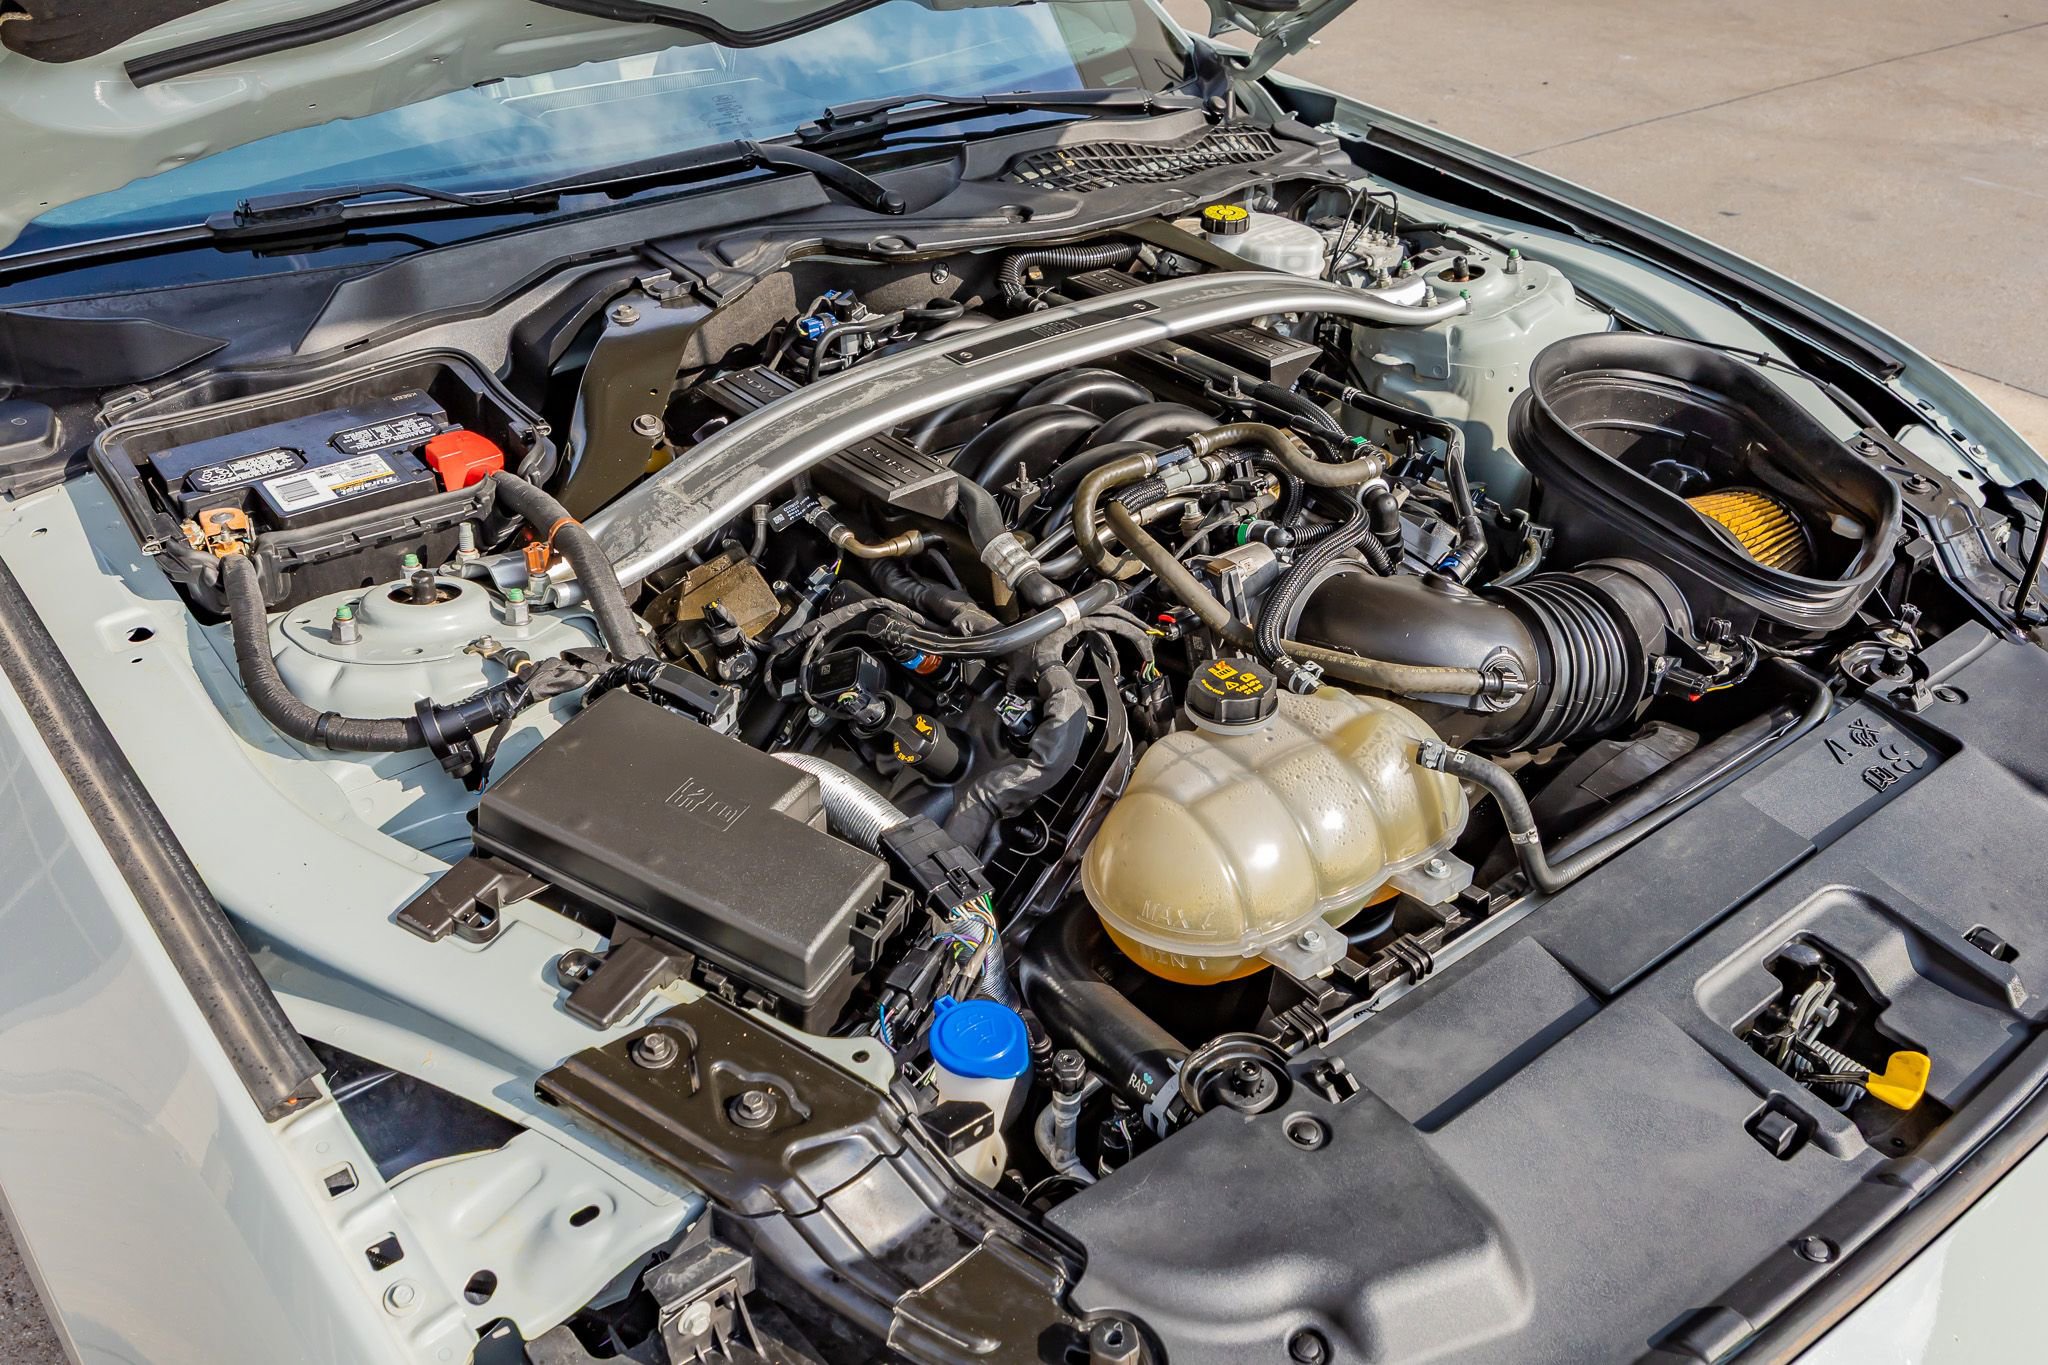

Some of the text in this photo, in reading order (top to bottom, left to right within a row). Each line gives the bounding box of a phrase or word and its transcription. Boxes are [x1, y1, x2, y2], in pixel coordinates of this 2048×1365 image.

[862, 446, 921, 479] FORD
[340, 476, 394, 495] Duralast
[1140, 899, 1190, 930] MAX
[1128, 1072, 1148, 1095] RAD
